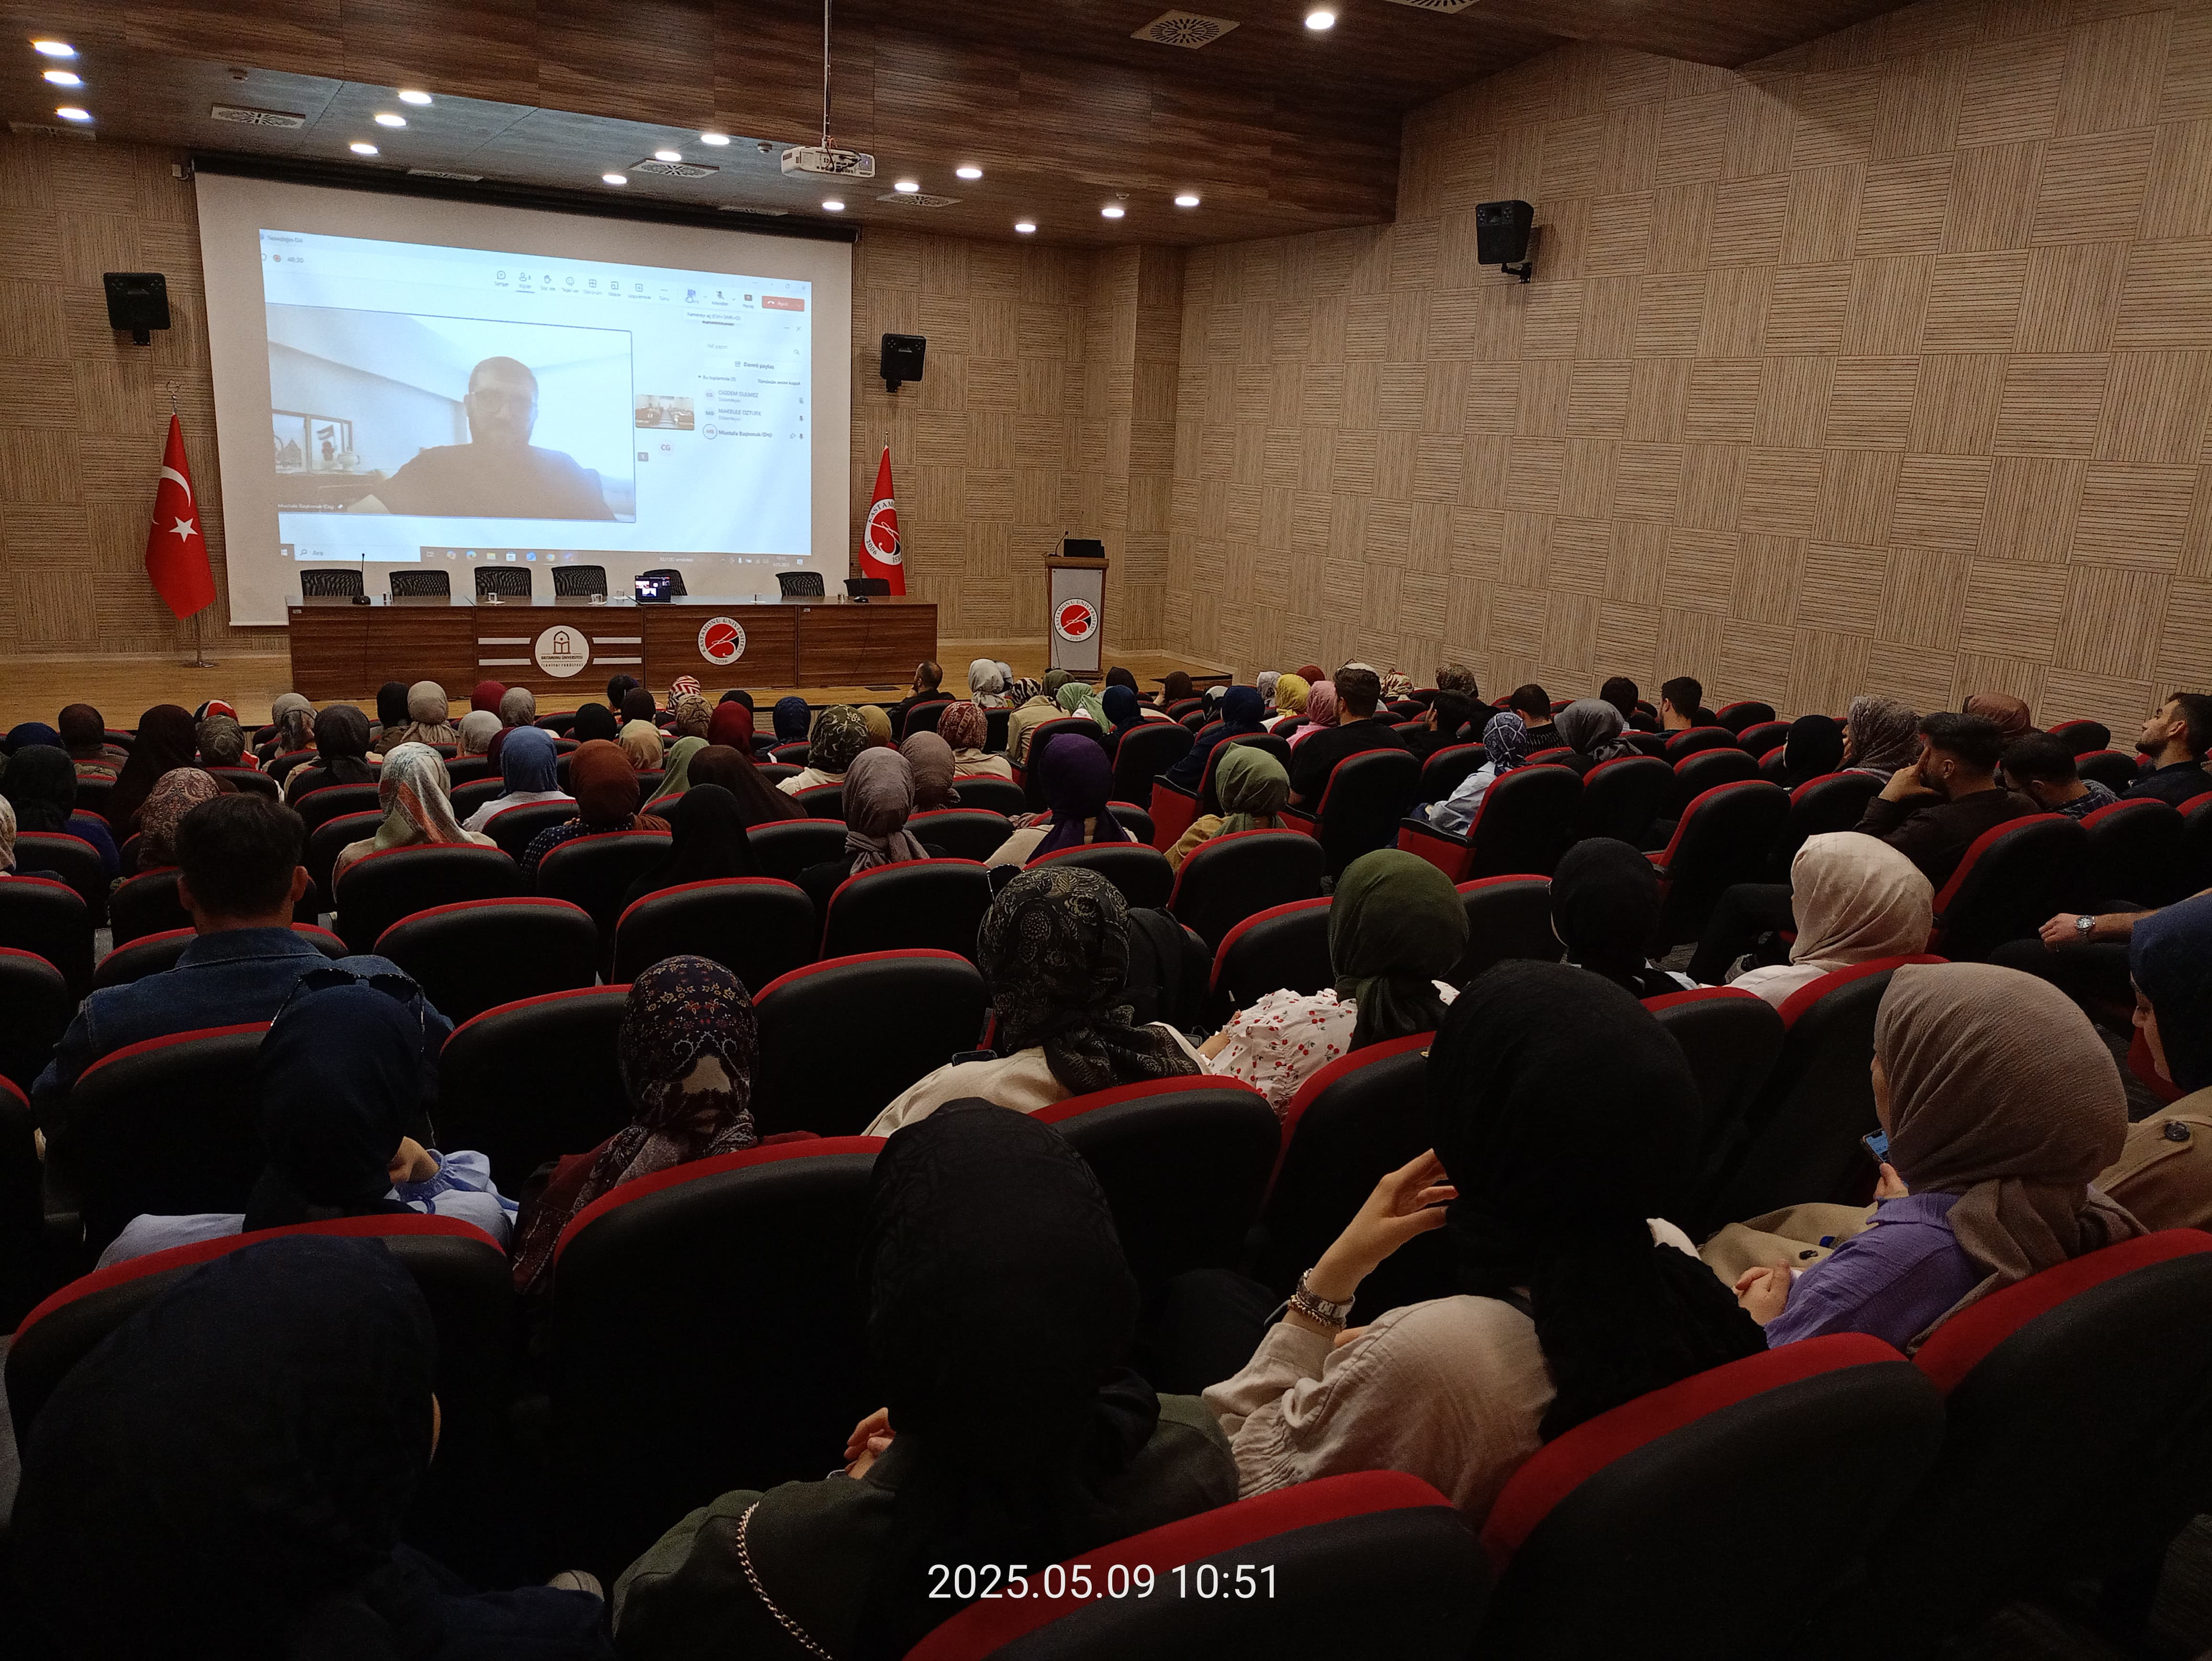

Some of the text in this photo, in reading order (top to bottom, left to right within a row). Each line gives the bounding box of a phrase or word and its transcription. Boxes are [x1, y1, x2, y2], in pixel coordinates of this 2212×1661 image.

[868, 501, 896, 523] KASTAM
[866, 539, 877, 555] 2006
[1056, 600, 1074, 631] KASTAMONU
[700, 619, 720, 653] KASTAMONU
